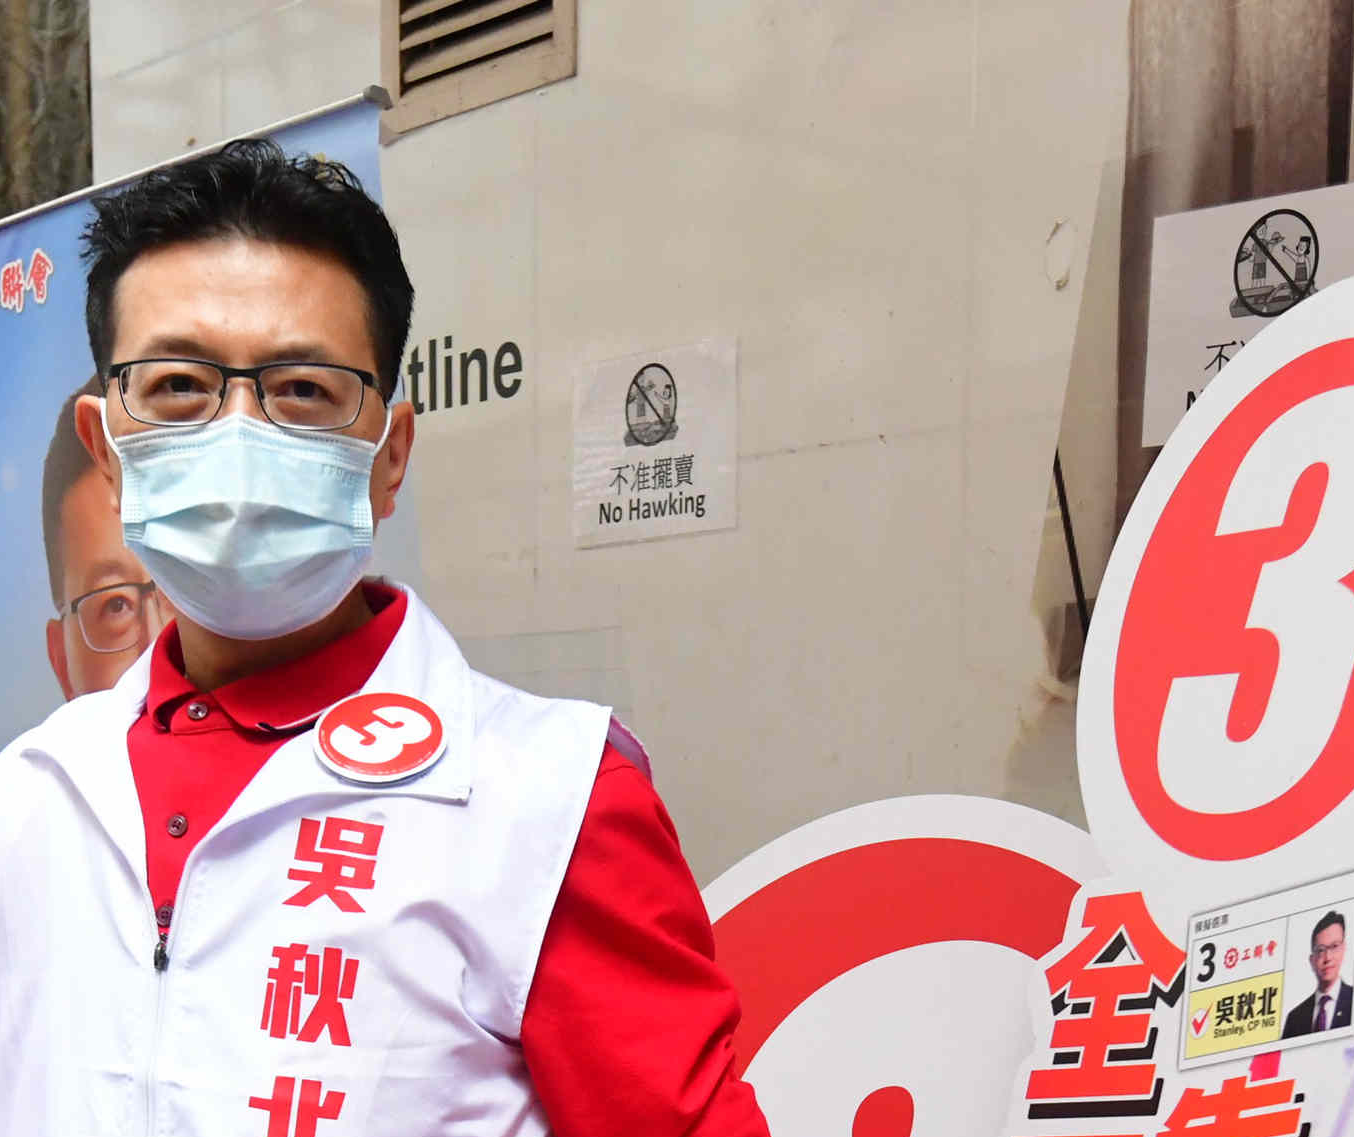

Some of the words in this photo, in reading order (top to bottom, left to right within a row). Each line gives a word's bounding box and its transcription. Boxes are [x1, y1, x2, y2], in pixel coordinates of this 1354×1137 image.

[403, 335, 523, 415] tline
[608, 454, 694, 495] 不准擺賣
[599, 502, 623, 524] No
[629, 492, 706, 520] Hawking
[329, 705, 432, 764] 3
[1197, 942, 1217, 983] 3
[1215, 986, 1278, 1027] 吳秋北
[1262, 1016, 1276, 1029] NG
